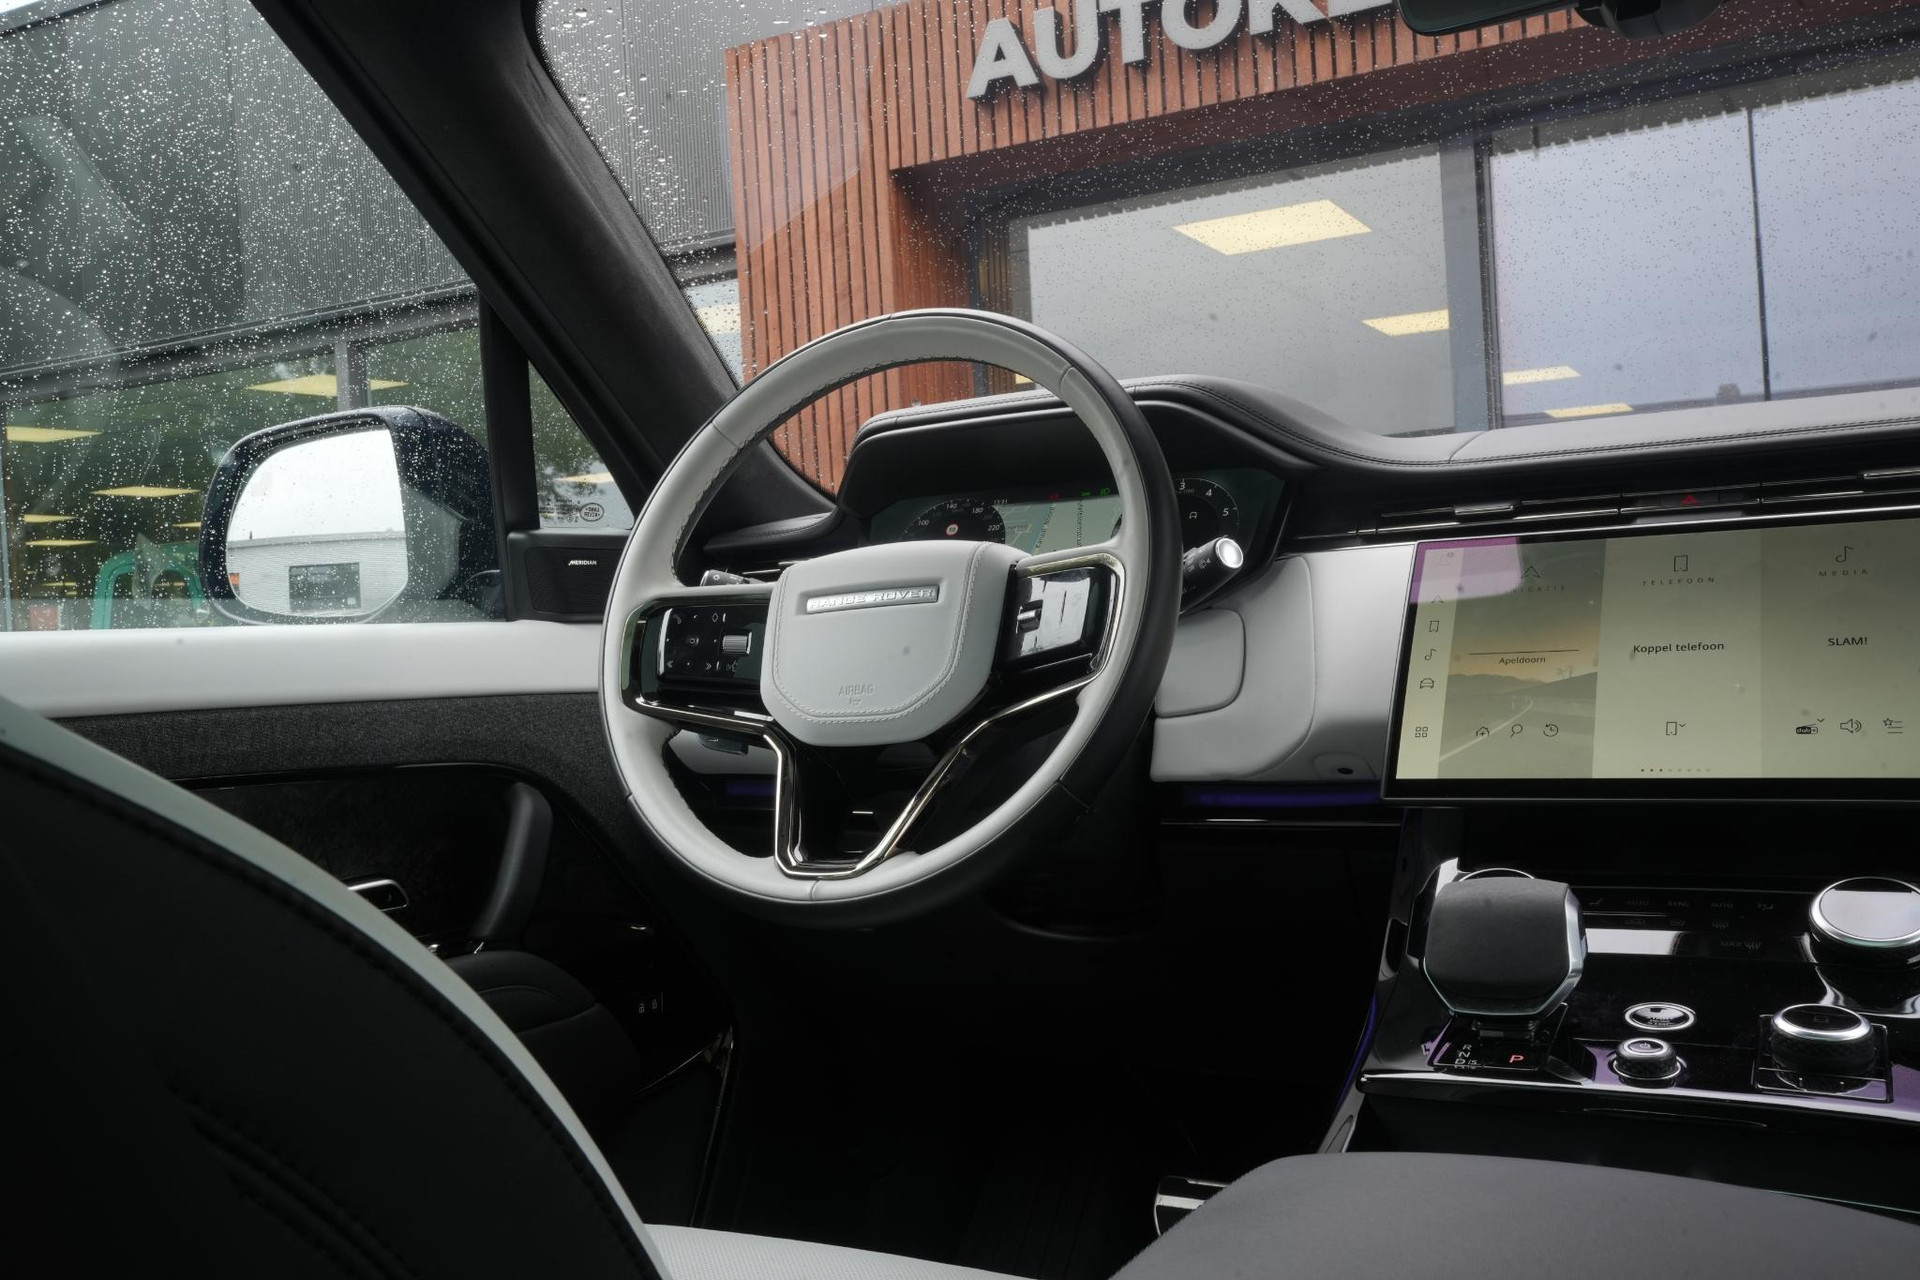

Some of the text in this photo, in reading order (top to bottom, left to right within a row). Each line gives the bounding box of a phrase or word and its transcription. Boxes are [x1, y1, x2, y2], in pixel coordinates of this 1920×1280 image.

[1818, 568, 1868, 577] MEDIA
[1642, 576, 1716, 586] TELEFOON
[810, 588, 936, 609] RANGE ROVER
[1827, 636, 1869, 647] SLAM!
[1633, 641, 1725, 655] Koppel telefoon
[1498, 656, 1546, 666] Apeldoorn
[838, 683, 875, 697] AIRBAG
[1508, 1054, 1524, 1063] P
